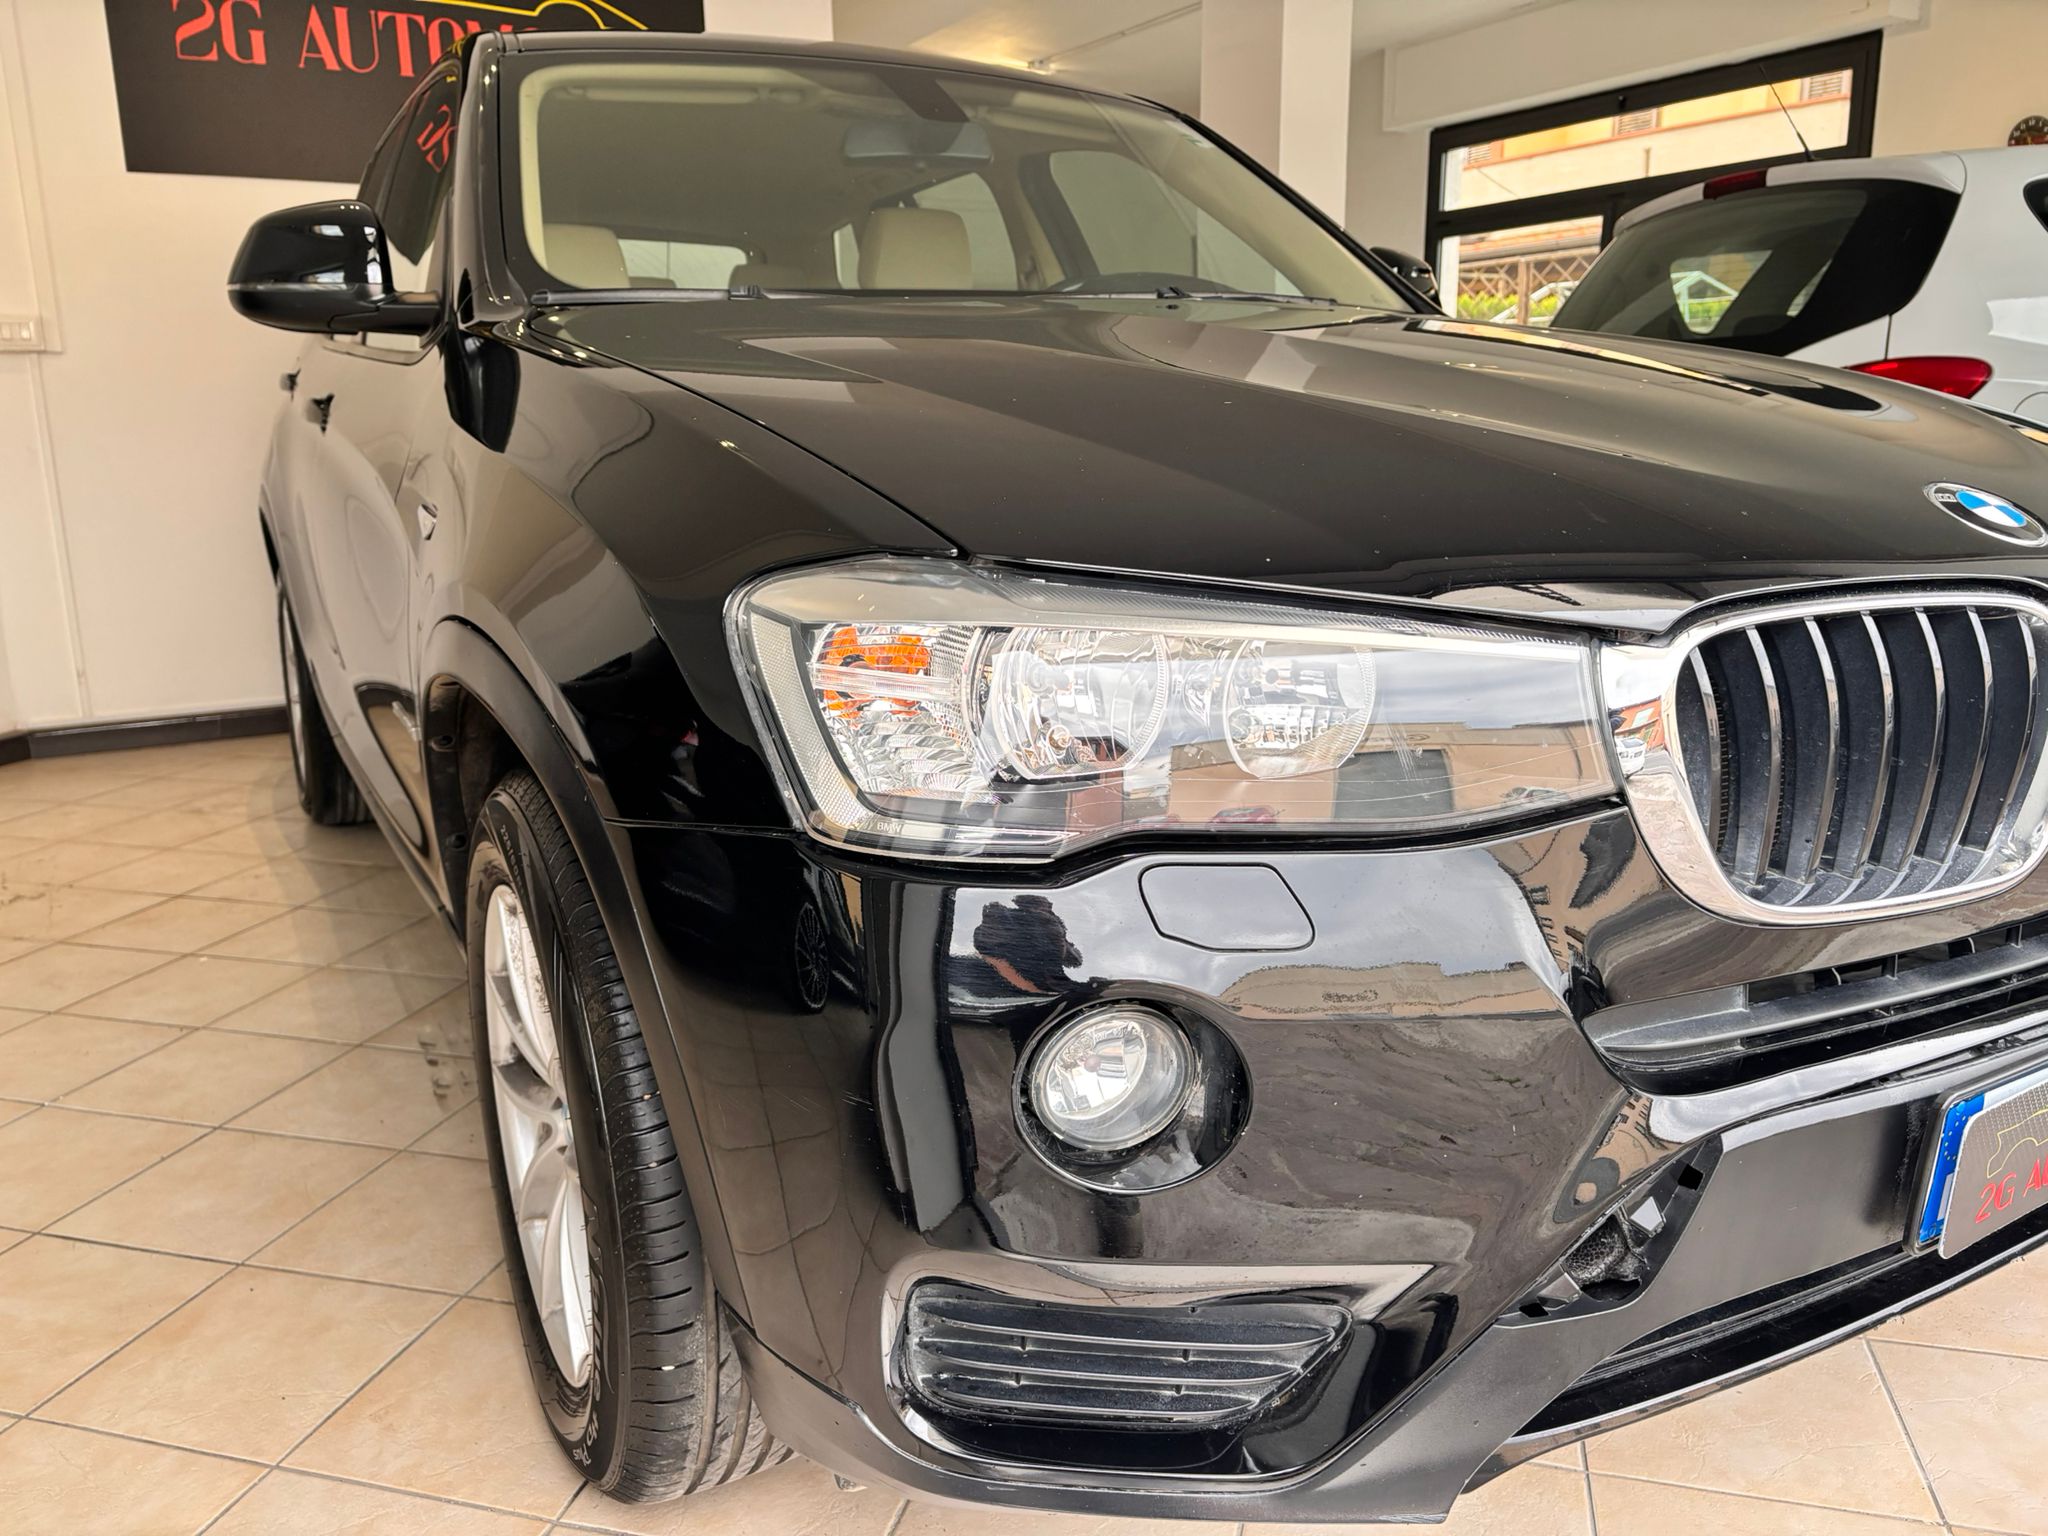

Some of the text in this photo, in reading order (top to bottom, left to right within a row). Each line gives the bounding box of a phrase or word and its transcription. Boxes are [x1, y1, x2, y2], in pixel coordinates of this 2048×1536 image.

[172, 0, 538, 78] 2G AUTO
[1975, 1172, 2017, 1223] 2G
